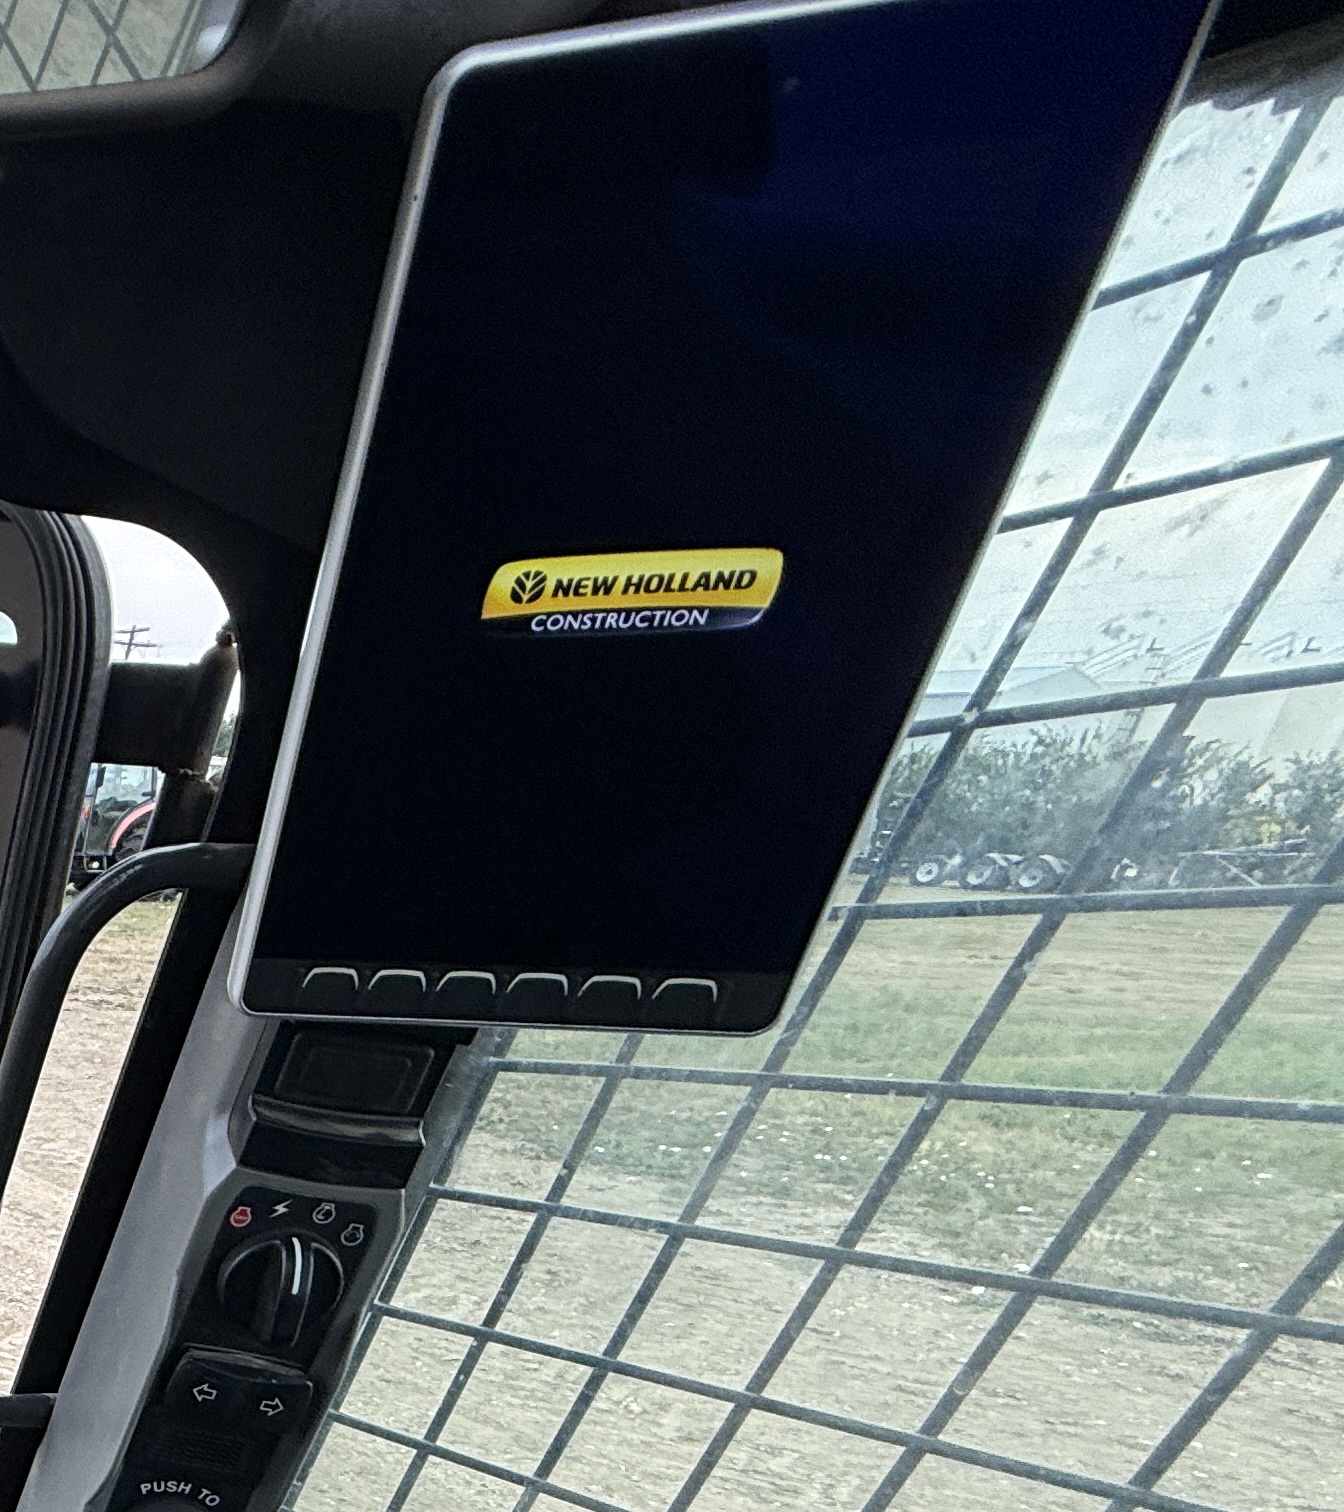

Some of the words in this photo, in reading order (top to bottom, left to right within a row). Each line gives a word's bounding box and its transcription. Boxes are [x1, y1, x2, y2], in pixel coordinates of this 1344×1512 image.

[551, 575, 619, 598] NEW
[621, 569, 758, 596] HOLLAND
[530, 608, 710, 632] CONSTRUCTION
[140, 1480, 193, 1495] PUSH
[197, 1488, 221, 1507] TO
